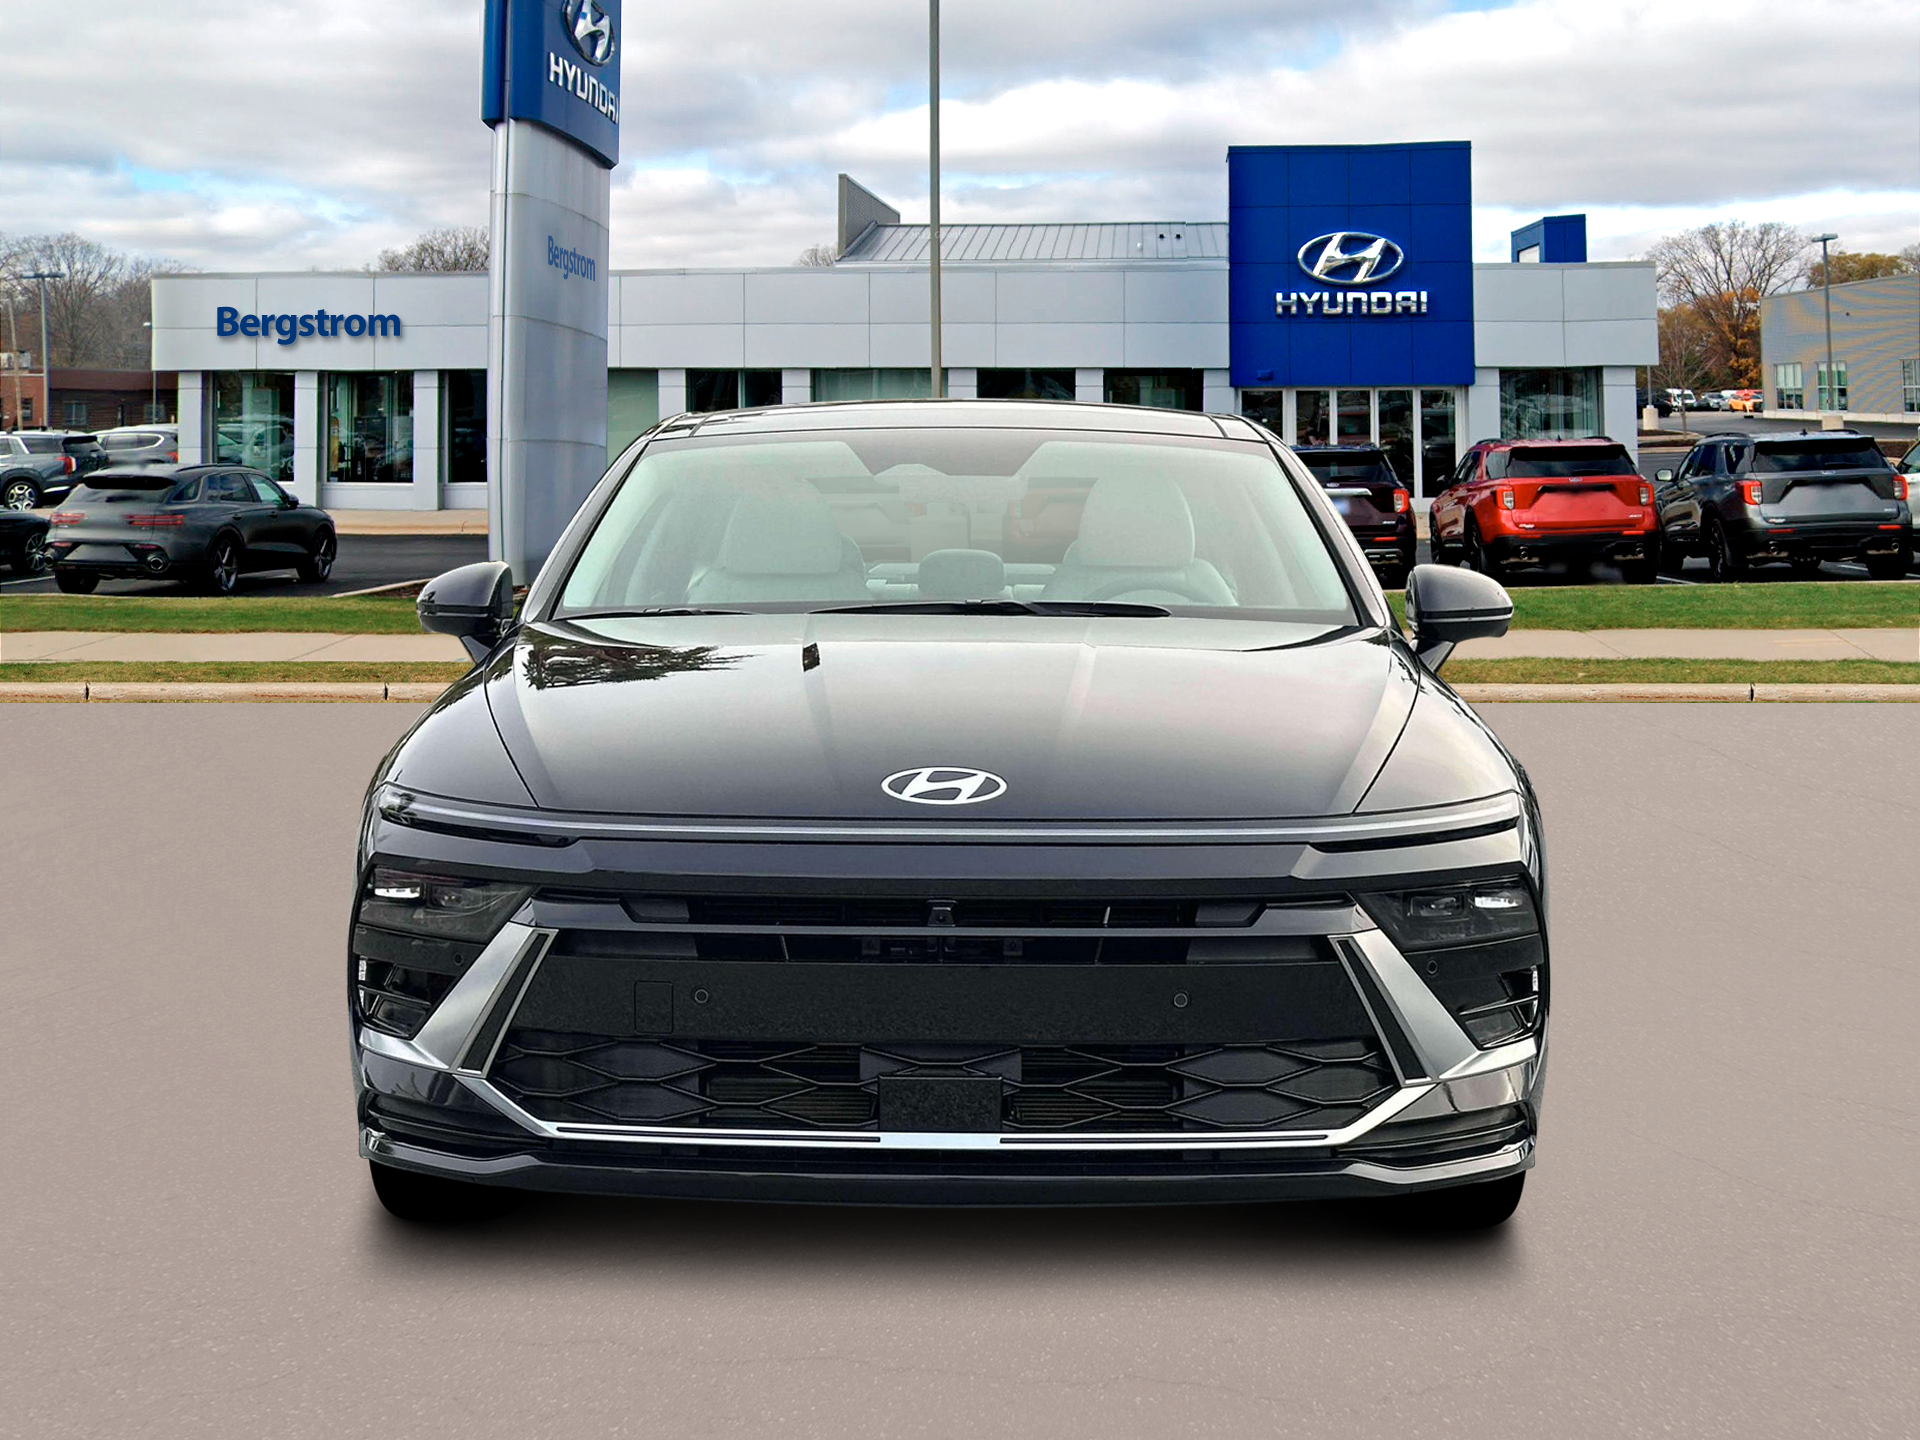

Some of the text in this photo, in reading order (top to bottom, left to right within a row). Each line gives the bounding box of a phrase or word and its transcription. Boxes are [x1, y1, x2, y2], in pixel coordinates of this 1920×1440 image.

[548, 51, 618, 124] HYUNDAI
[547, 235, 596, 281] Bergstrom
[1275, 290, 1428, 315] HYUNDAI
[216, 306, 402, 346] Bergstrom
